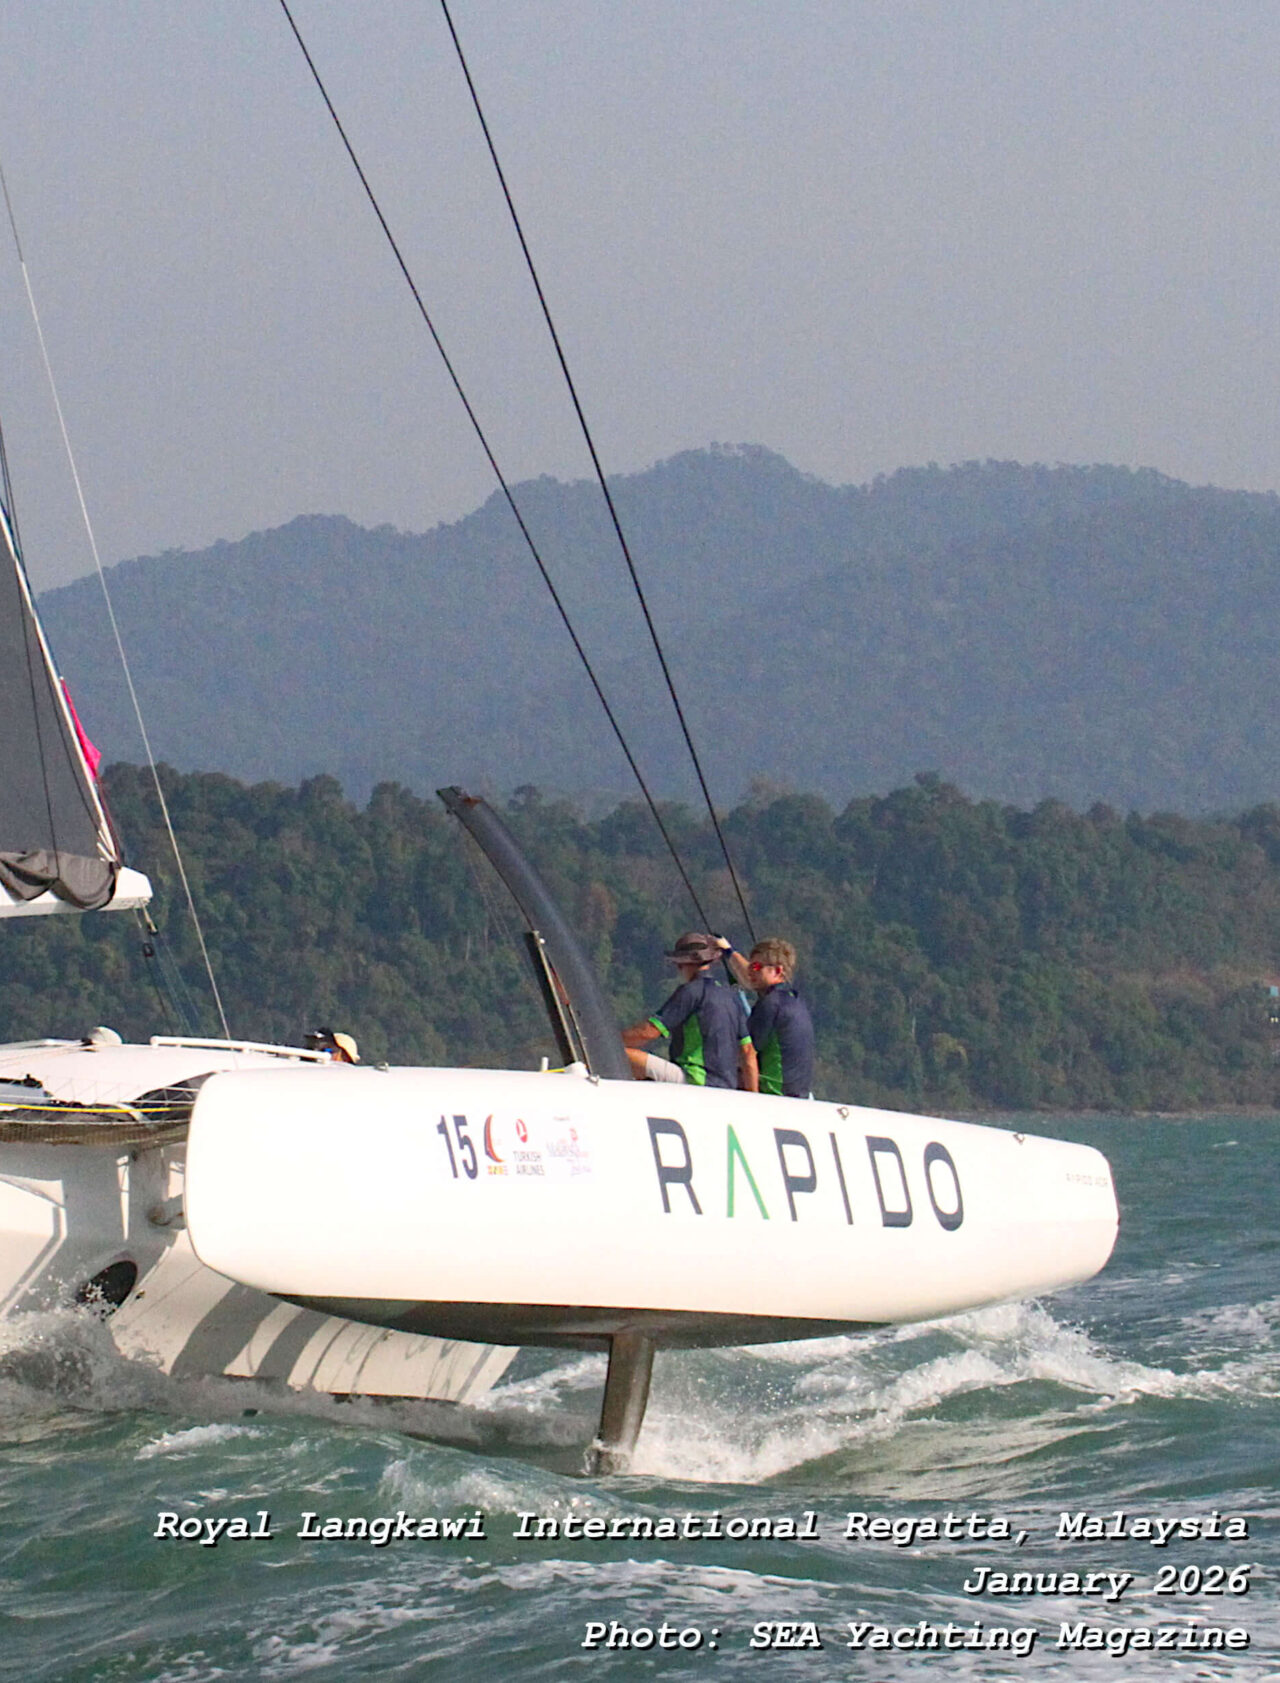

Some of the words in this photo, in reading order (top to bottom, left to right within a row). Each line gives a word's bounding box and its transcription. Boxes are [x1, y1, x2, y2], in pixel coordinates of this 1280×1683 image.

[436, 1114, 479, 1180] 15
[513, 1150, 543, 1163] TURKISH
[646, 1116, 964, 1232] RAPIDO
